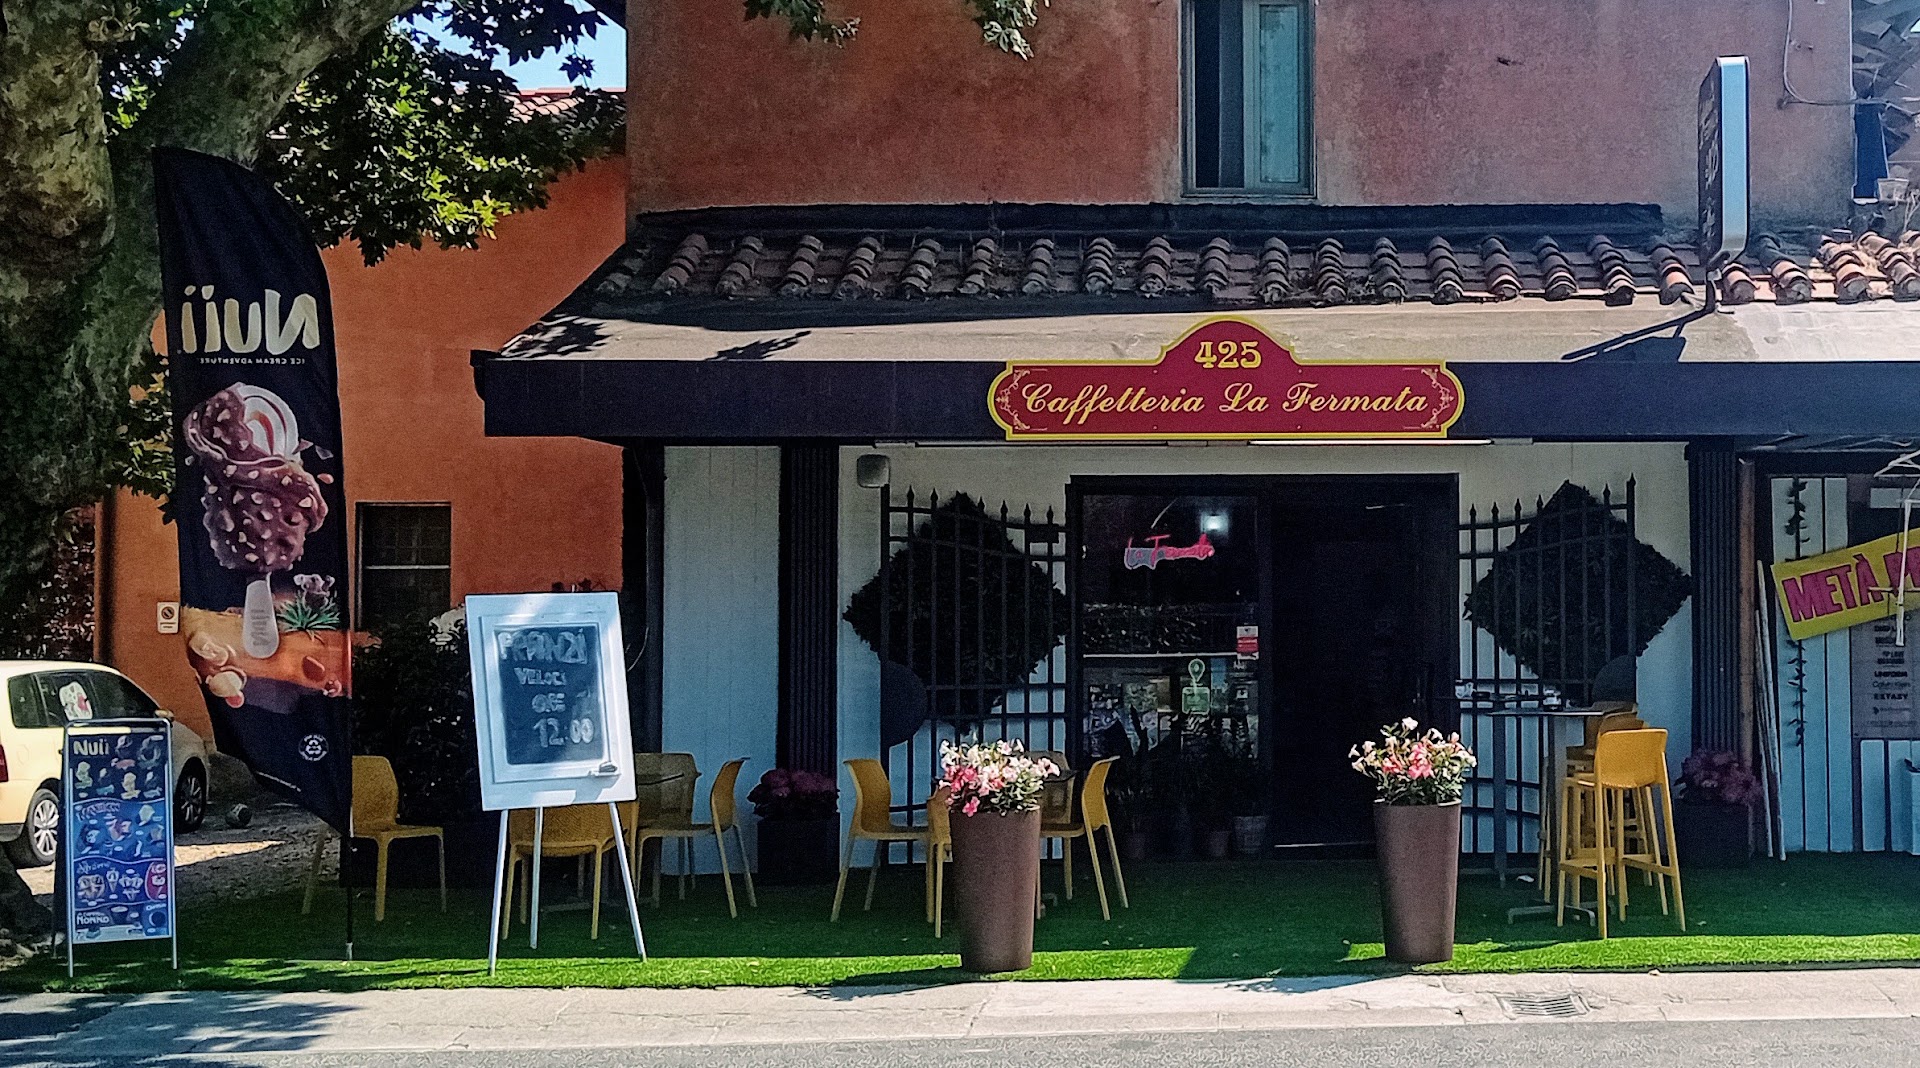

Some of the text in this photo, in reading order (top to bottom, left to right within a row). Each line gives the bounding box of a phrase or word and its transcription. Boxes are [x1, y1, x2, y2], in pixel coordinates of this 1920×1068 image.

[1194, 341, 1262, 369] 425
[1021, 382, 1428, 425] Caffetteria La Fermata
[1781, 552, 1884, 623] METÀ
